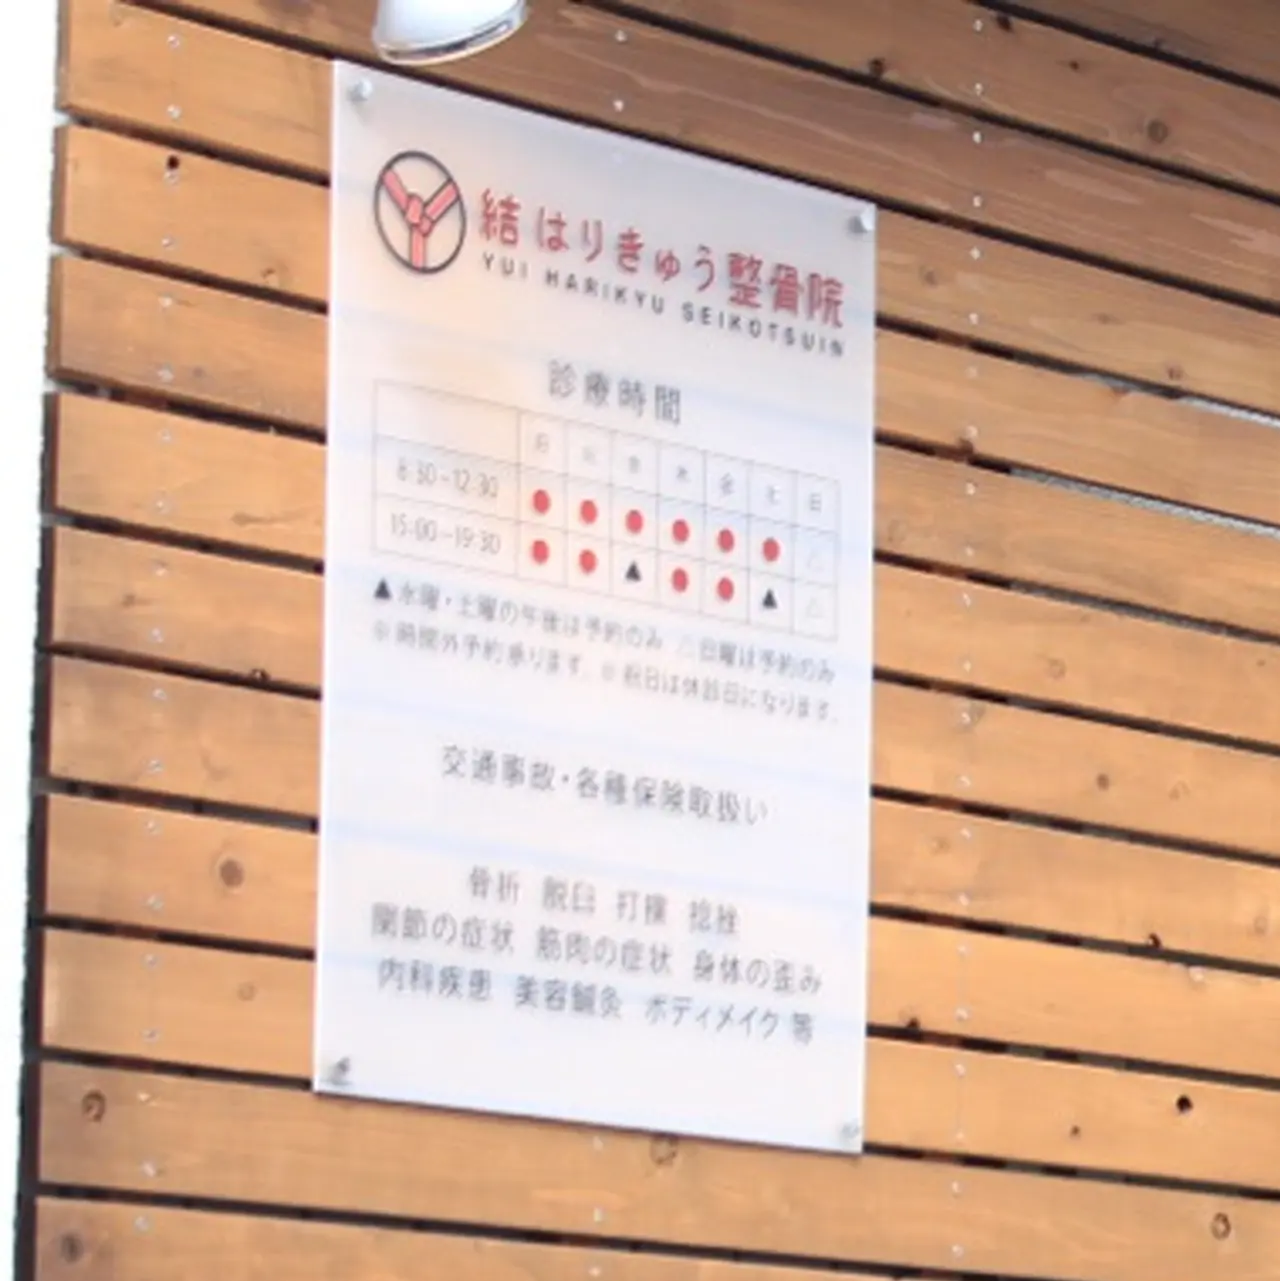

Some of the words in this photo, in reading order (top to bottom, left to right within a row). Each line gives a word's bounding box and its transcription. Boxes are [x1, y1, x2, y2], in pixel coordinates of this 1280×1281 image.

[483, 251, 529, 279] YUI
[545, 269, 665, 315] HARIKYU
[682, 301, 844, 358] SEIKOTSUIN
[548, 359, 681, 426] 診療時間
